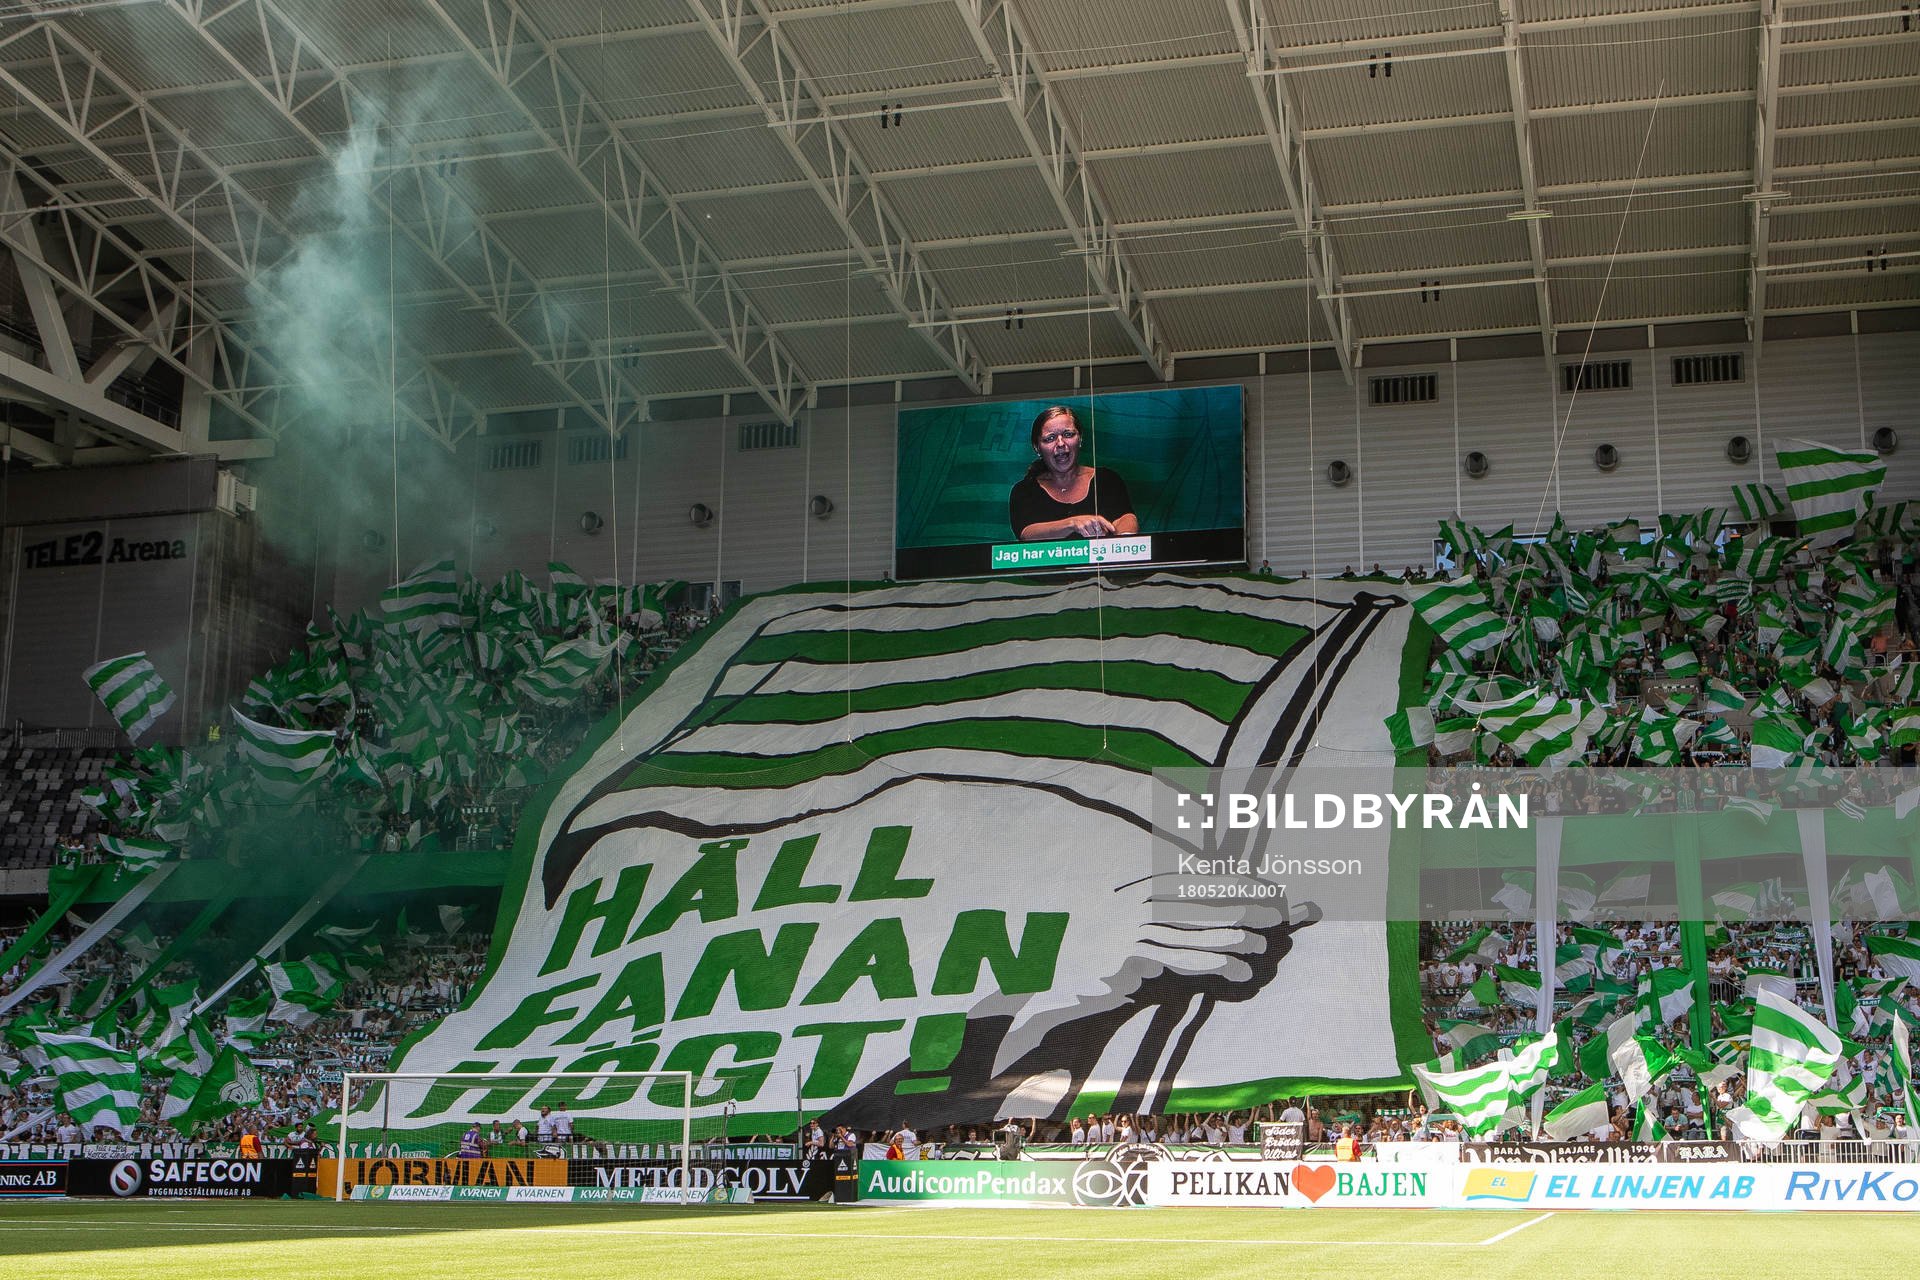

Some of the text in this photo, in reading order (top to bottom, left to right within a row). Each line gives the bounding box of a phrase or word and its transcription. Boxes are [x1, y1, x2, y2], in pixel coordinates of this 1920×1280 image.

[24, 531, 186, 569] TELE2 Arena
[995, 542, 1147, 563] Jag har väntat så länge
[537, 826, 935, 977] HÅLL
[476, 909, 1069, 1052] FANAN
[404, 1012, 968, 1119] HÖGT!
[1265, 1126, 1296, 1136] Söder
[1265, 1137, 1301, 1148] Bröder
[1494, 1145, 1656, 1155] BARA BAJARE 1996
[1264, 1148, 1298, 1160] Ultras
[33, 1170, 57, 1186] AB
[868, 1170, 1066, 1194] AudicomPendax
[1171, 1172, 1428, 1197] PELIKAN BAJEN
[1491, 1176, 1507, 1187] EL
[148, 1187, 251, 1197] BYGGNADSSTÄLLNINGAR AB
[392, 1186, 439, 1197] KVARNEN
[516, 1188, 565, 1198] KVARNEN
[1545, 1175, 1756, 1199] EL LINJEN AB
